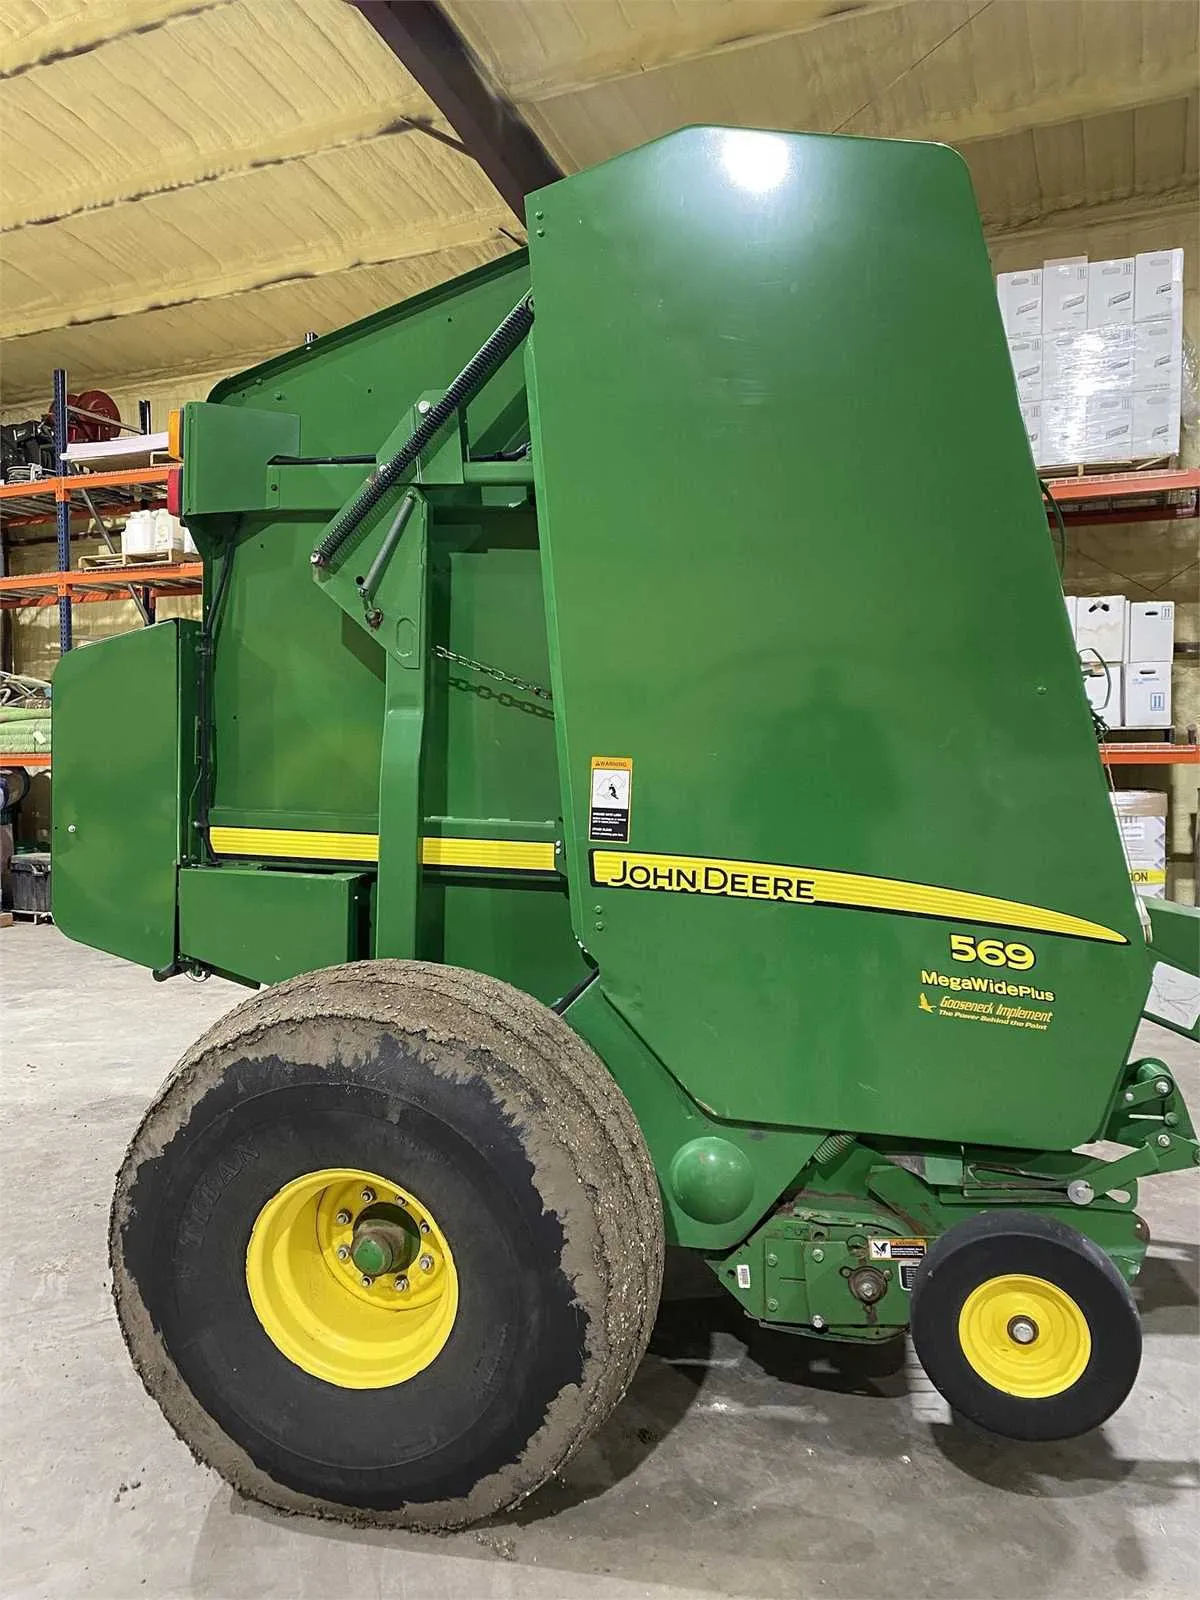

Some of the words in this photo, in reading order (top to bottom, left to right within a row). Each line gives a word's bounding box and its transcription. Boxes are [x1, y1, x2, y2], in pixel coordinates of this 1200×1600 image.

[611, 860, 697, 889] JOHN
[704, 867, 815, 900] DEERE
[950, 934, 1036, 970] 569
[921, 970, 1055, 1001] MegaWidePlus
[939, 1009, 954, 1017] The
[980, 1015, 1009, 1025] Behind
[1010, 1020, 1024, 1028] the
[940, 995, 993, 1014] Gooseneck
[996, 1003, 1053, 1022] Implement
